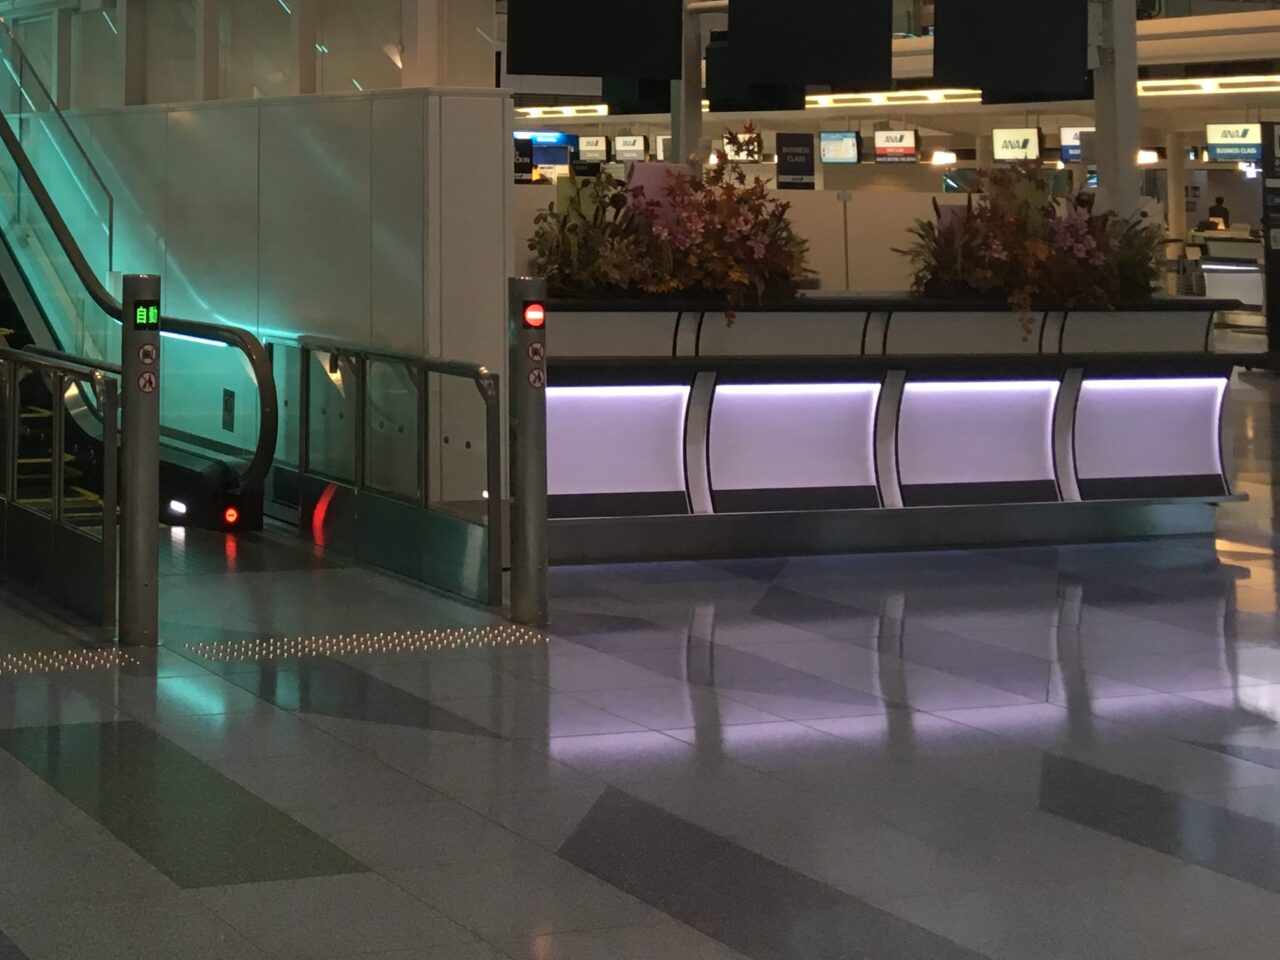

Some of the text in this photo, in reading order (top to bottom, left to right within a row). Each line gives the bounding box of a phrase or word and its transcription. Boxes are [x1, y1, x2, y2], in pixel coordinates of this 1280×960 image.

[1221, 129, 1240, 138] ANA
[1001, 140, 1020, 150] ANA
[136, 305, 158, 324] 自動
